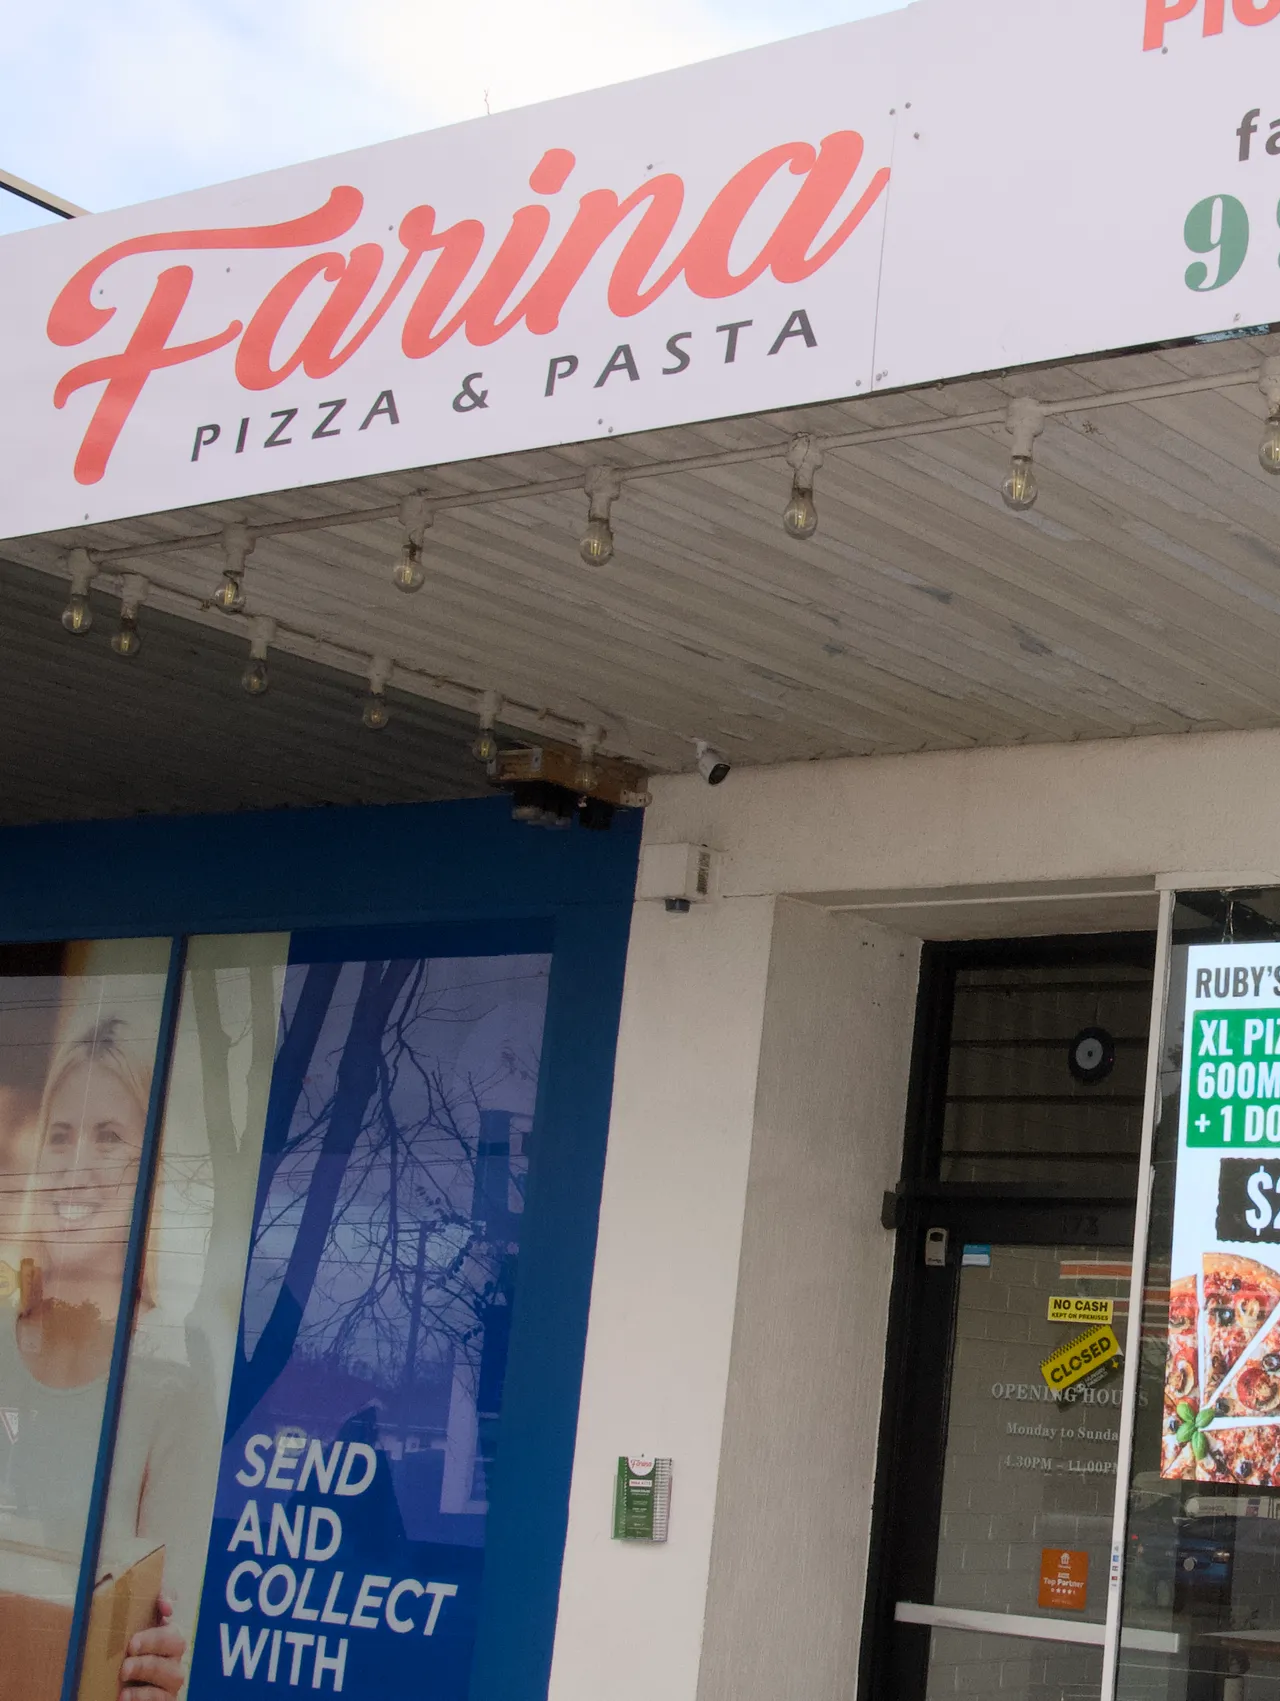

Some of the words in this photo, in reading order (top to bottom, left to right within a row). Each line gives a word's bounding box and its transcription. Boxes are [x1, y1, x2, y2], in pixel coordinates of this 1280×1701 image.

[46, 130, 891, 485] Farina
[191, 390, 400, 462] PIZZA
[451, 372, 489, 413] &
[545, 308, 819, 397] PASTA
[1198, 1019, 1233, 1056] XL
[1220, 1106, 1233, 1142] 1
[1053, 1299, 1071, 1310] NO
[1075, 1300, 1109, 1312] CASH
[1050, 1337, 1111, 1383] CLOSED
[992, 1382, 1077, 1404] OPENING
[1006, 1422, 1057, 1440] Monday
[1061, 1427, 1074, 1438] to
[1077, 1427, 1119, 1441] Sunda
[236, 1434, 377, 1496] SEND
[227, 1500, 341, 1561] AND
[226, 1560, 457, 1636] COLLECT
[1043, 1577, 1057, 1587] Top
[1057, 1579, 1085, 1588] Partner
[219, 1622, 348, 1692] WITH
